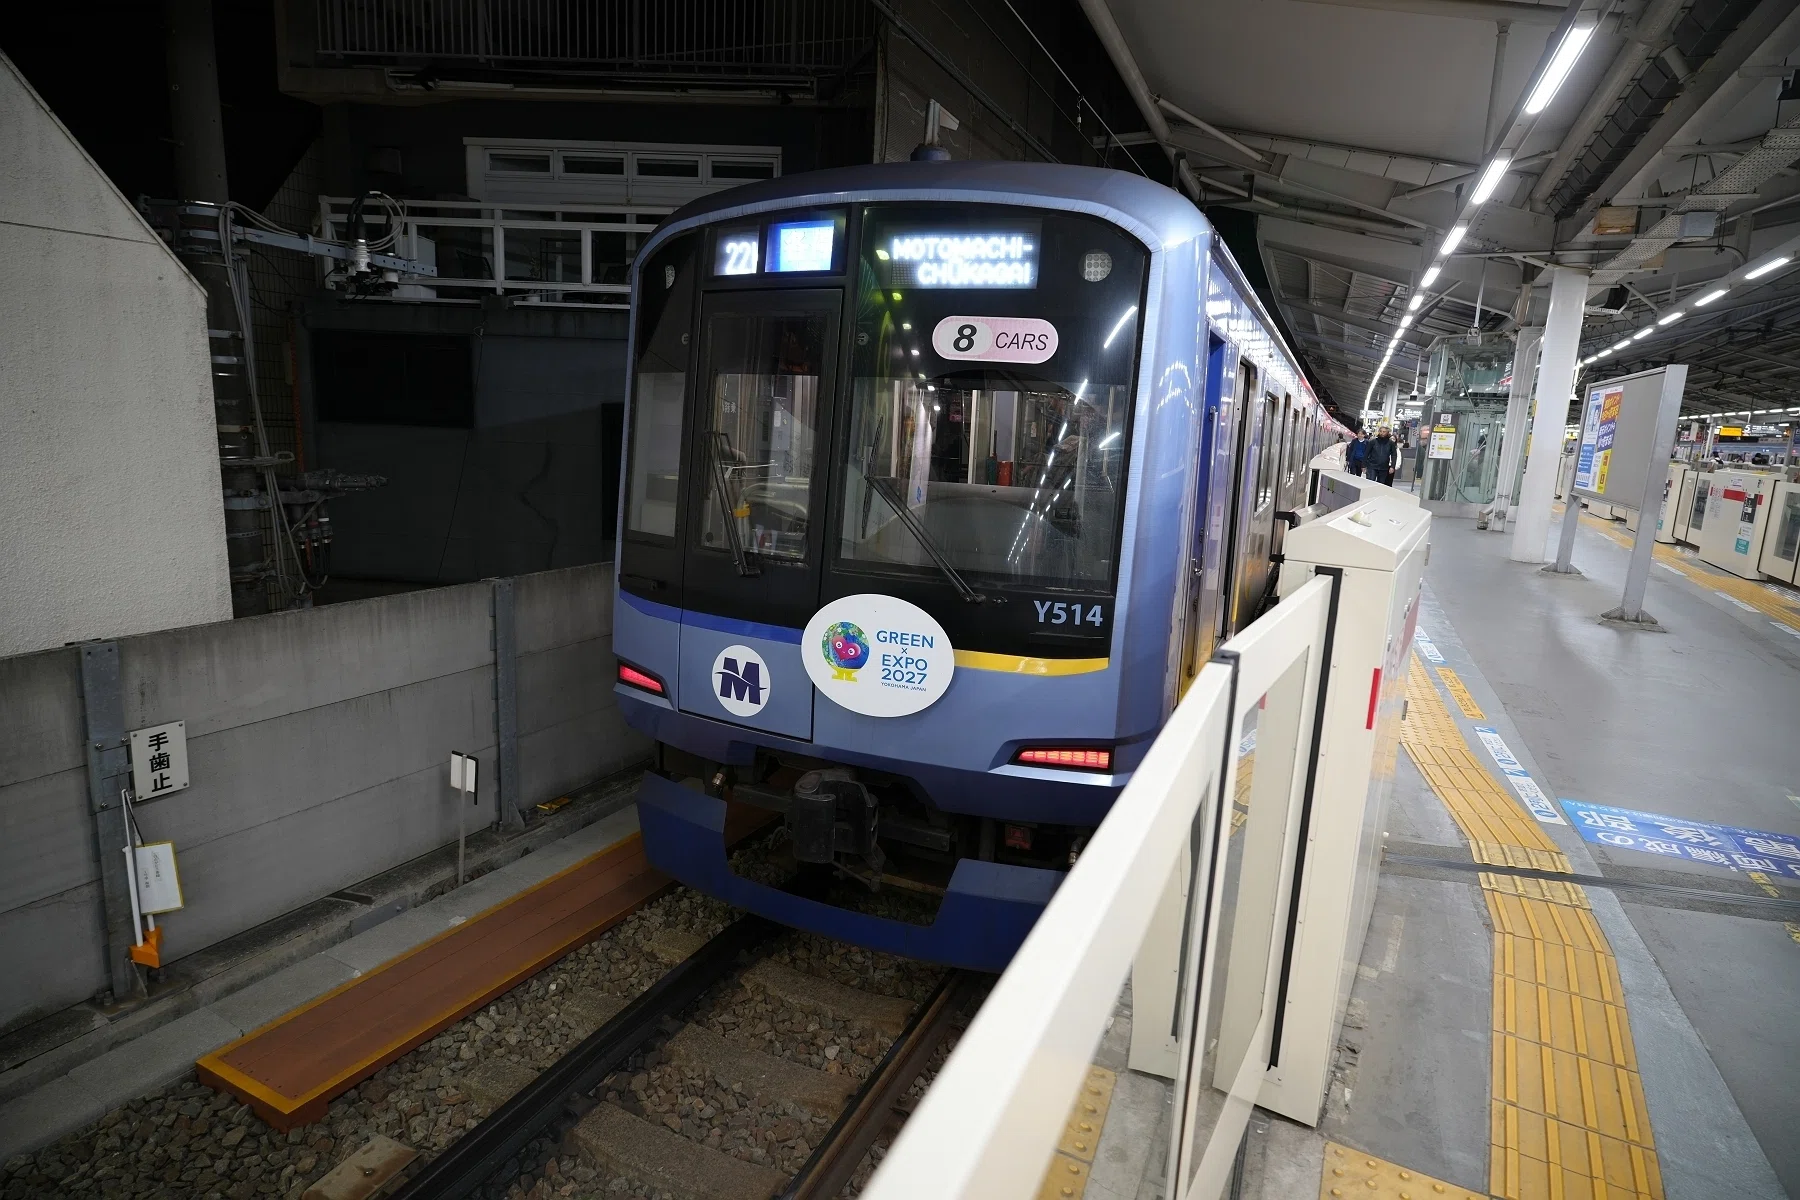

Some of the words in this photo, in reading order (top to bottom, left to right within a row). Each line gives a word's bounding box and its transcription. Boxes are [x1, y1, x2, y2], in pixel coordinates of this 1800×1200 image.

[892, 236, 1034, 260] MOTOMACHI-
[953, 324, 978, 353] 8
[995, 332, 1049, 351] CARS
[1033, 600, 1104, 627] Y514
[876, 630, 934, 649] GREEN
[882, 653, 928, 671] EXPO
[881, 667, 928, 685] 2027
[881, 682, 909, 690] YOKOHAMA
[149, 732, 172, 792] 手歯止
[1577, 810, 1800, 860] 最後部
